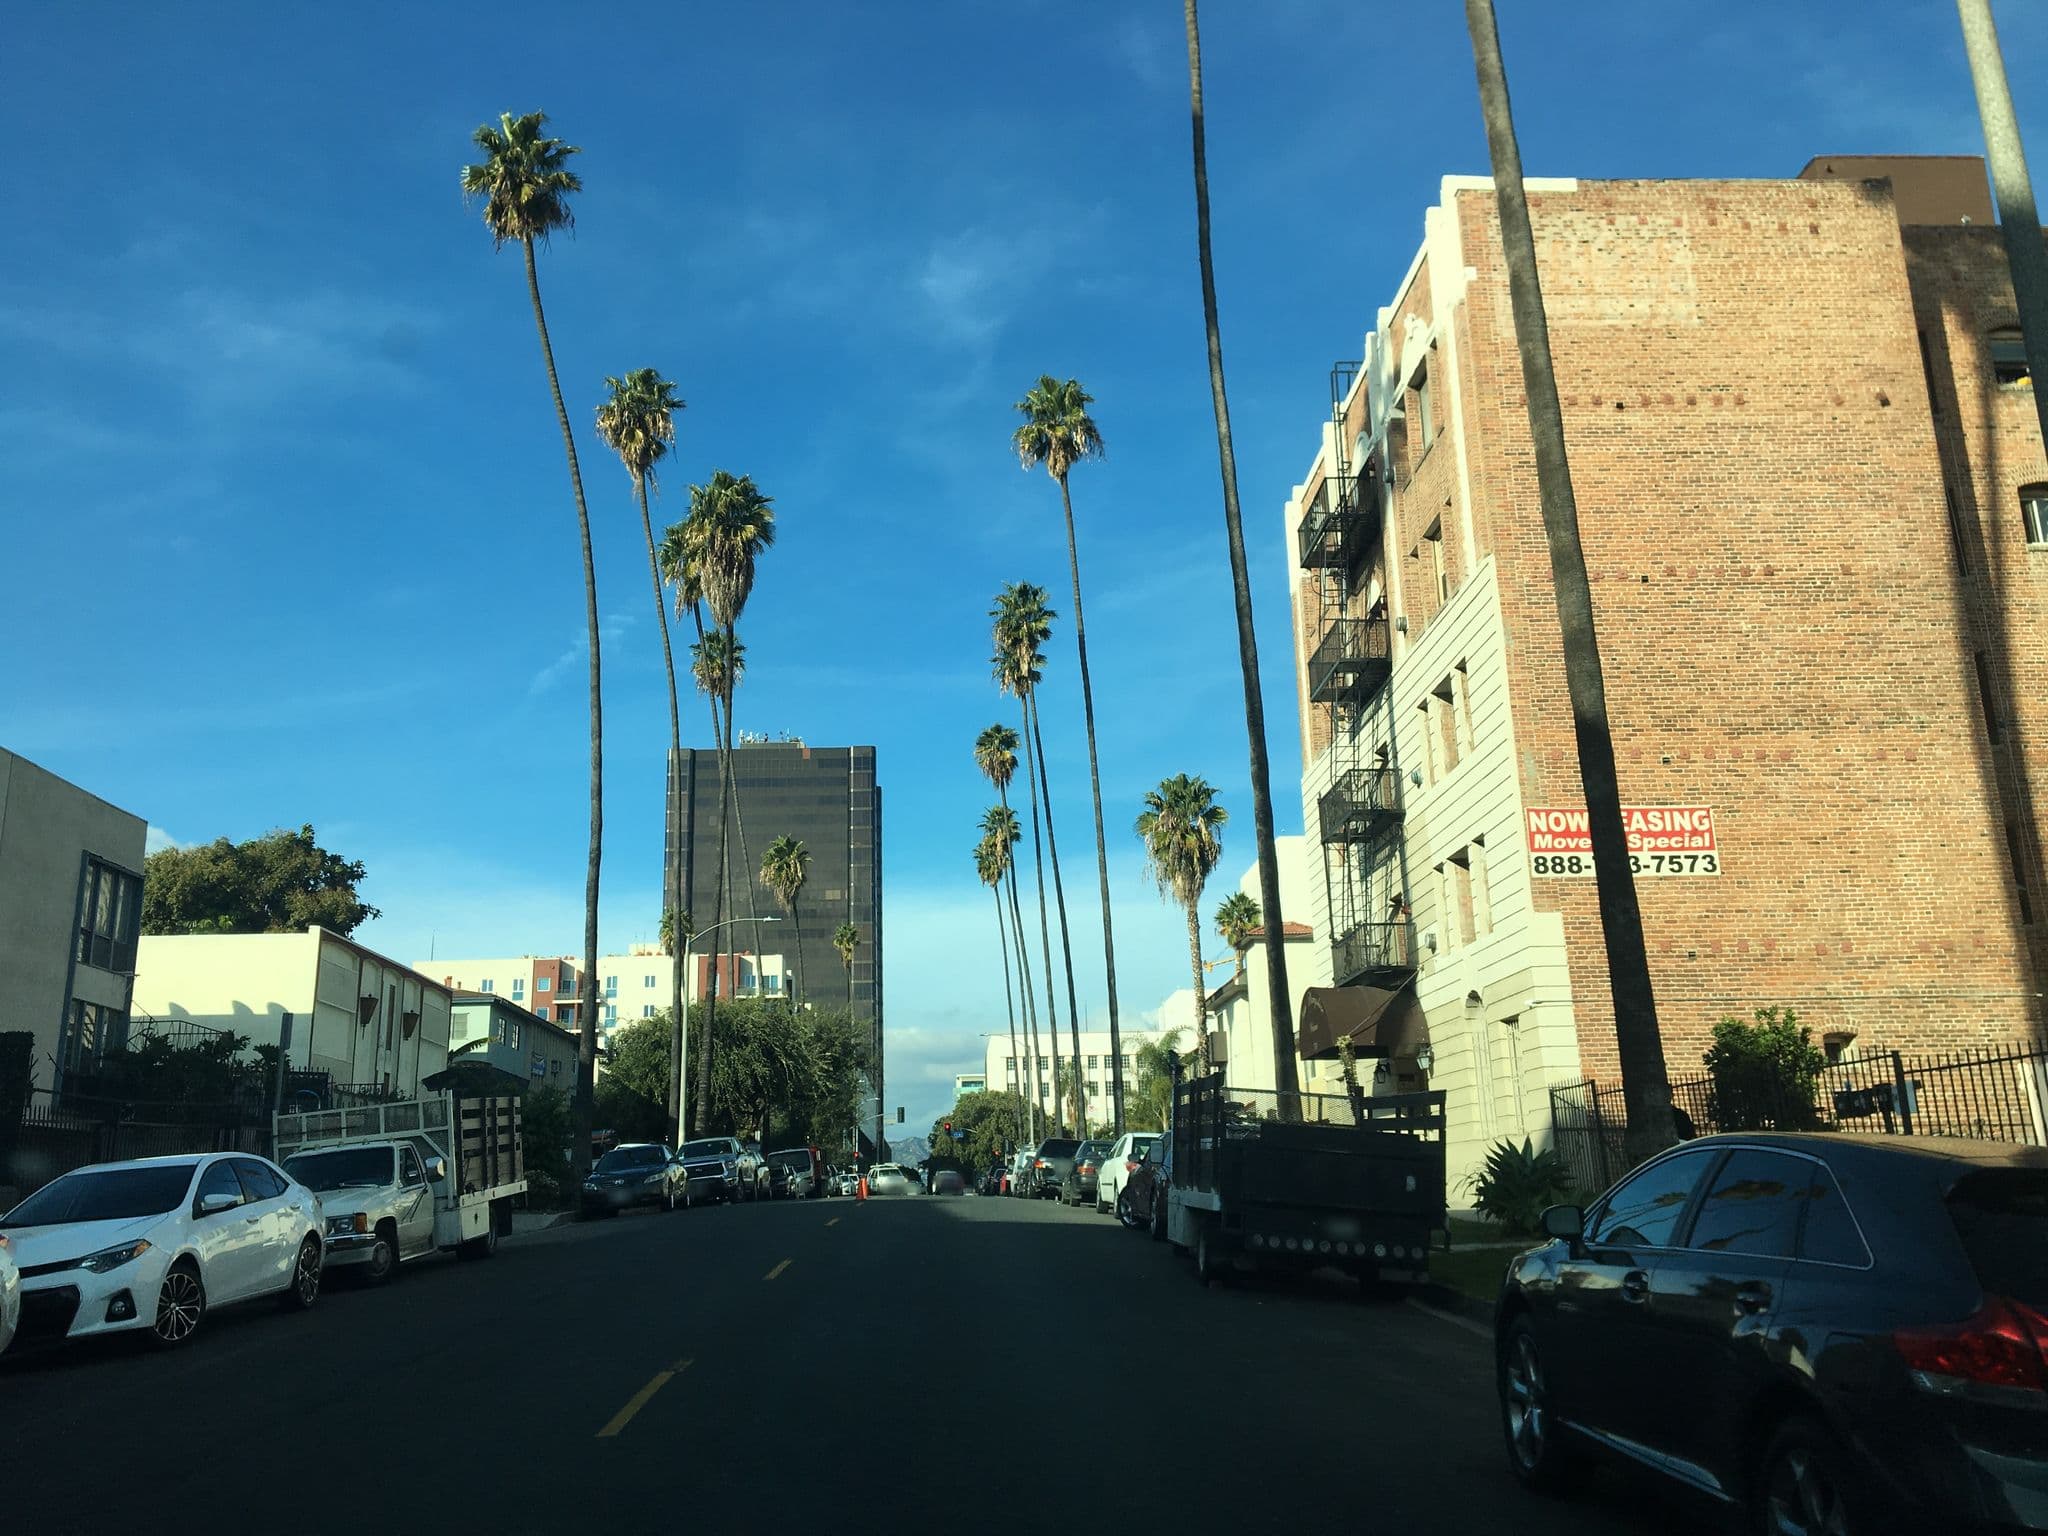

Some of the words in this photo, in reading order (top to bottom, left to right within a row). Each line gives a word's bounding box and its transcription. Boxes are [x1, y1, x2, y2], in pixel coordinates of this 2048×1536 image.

[1529, 812, 1590, 832] NOW
[1620, 810, 1711, 832] ASING
[1628, 833, 1711, 851] Special
[1534, 855, 1717, 874] 888-3-7573
